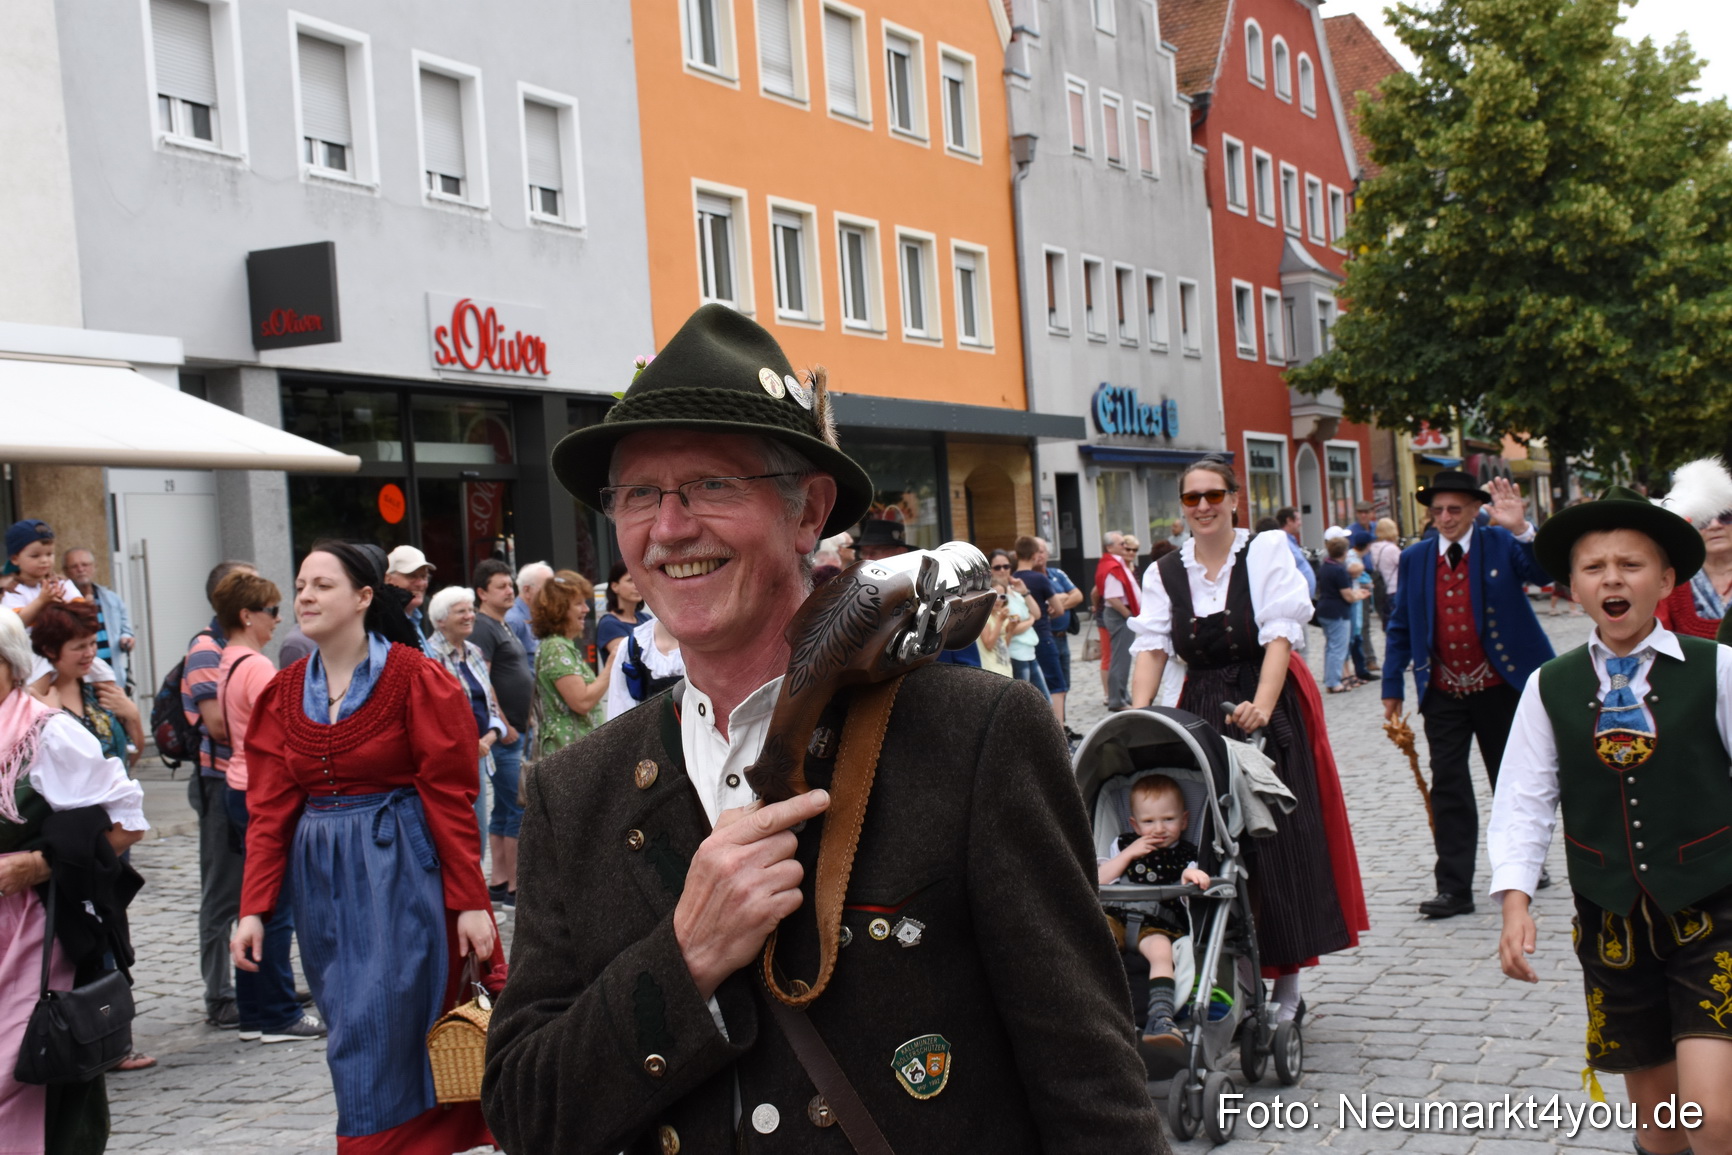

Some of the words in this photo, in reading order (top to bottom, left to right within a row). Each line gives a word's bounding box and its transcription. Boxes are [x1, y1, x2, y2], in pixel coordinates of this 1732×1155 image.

[261, 308, 324, 336] s.Oliver
[434, 298, 551, 375] s.Oliver
[1092, 382, 1162, 436] Eilles
